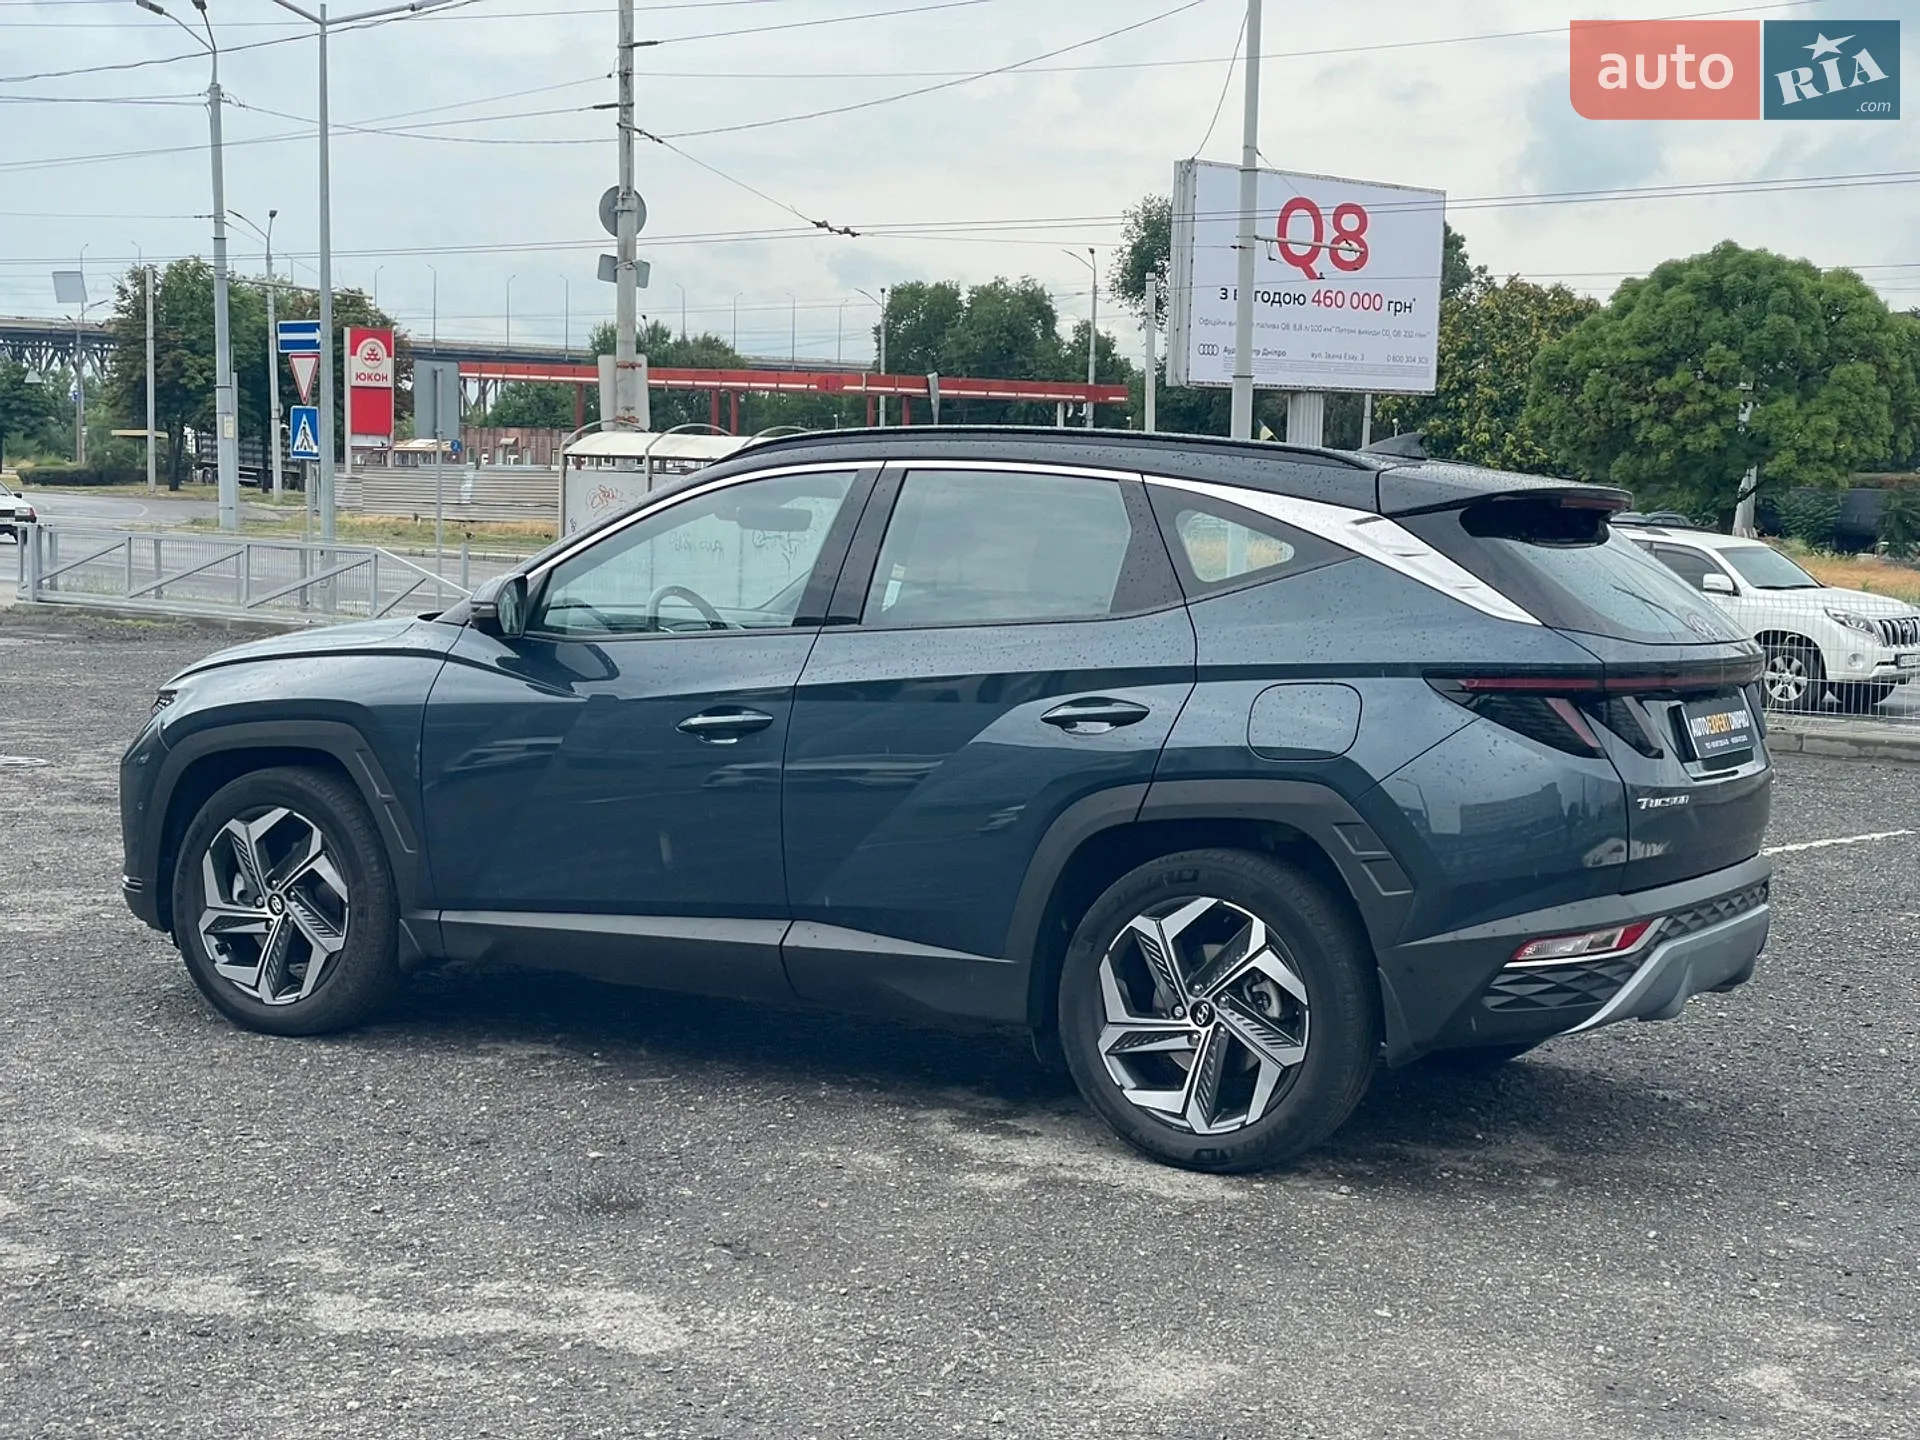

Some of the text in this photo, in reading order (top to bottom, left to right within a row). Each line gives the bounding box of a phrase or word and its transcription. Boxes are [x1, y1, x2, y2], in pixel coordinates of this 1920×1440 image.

[1276, 196, 1369, 280] Q8
[1234, 288, 1307, 307] годою
[1311, 288, 1345, 309] 460
[1350, 292, 1383, 311] 000
[355, 372, 388, 382] ЮКОН
